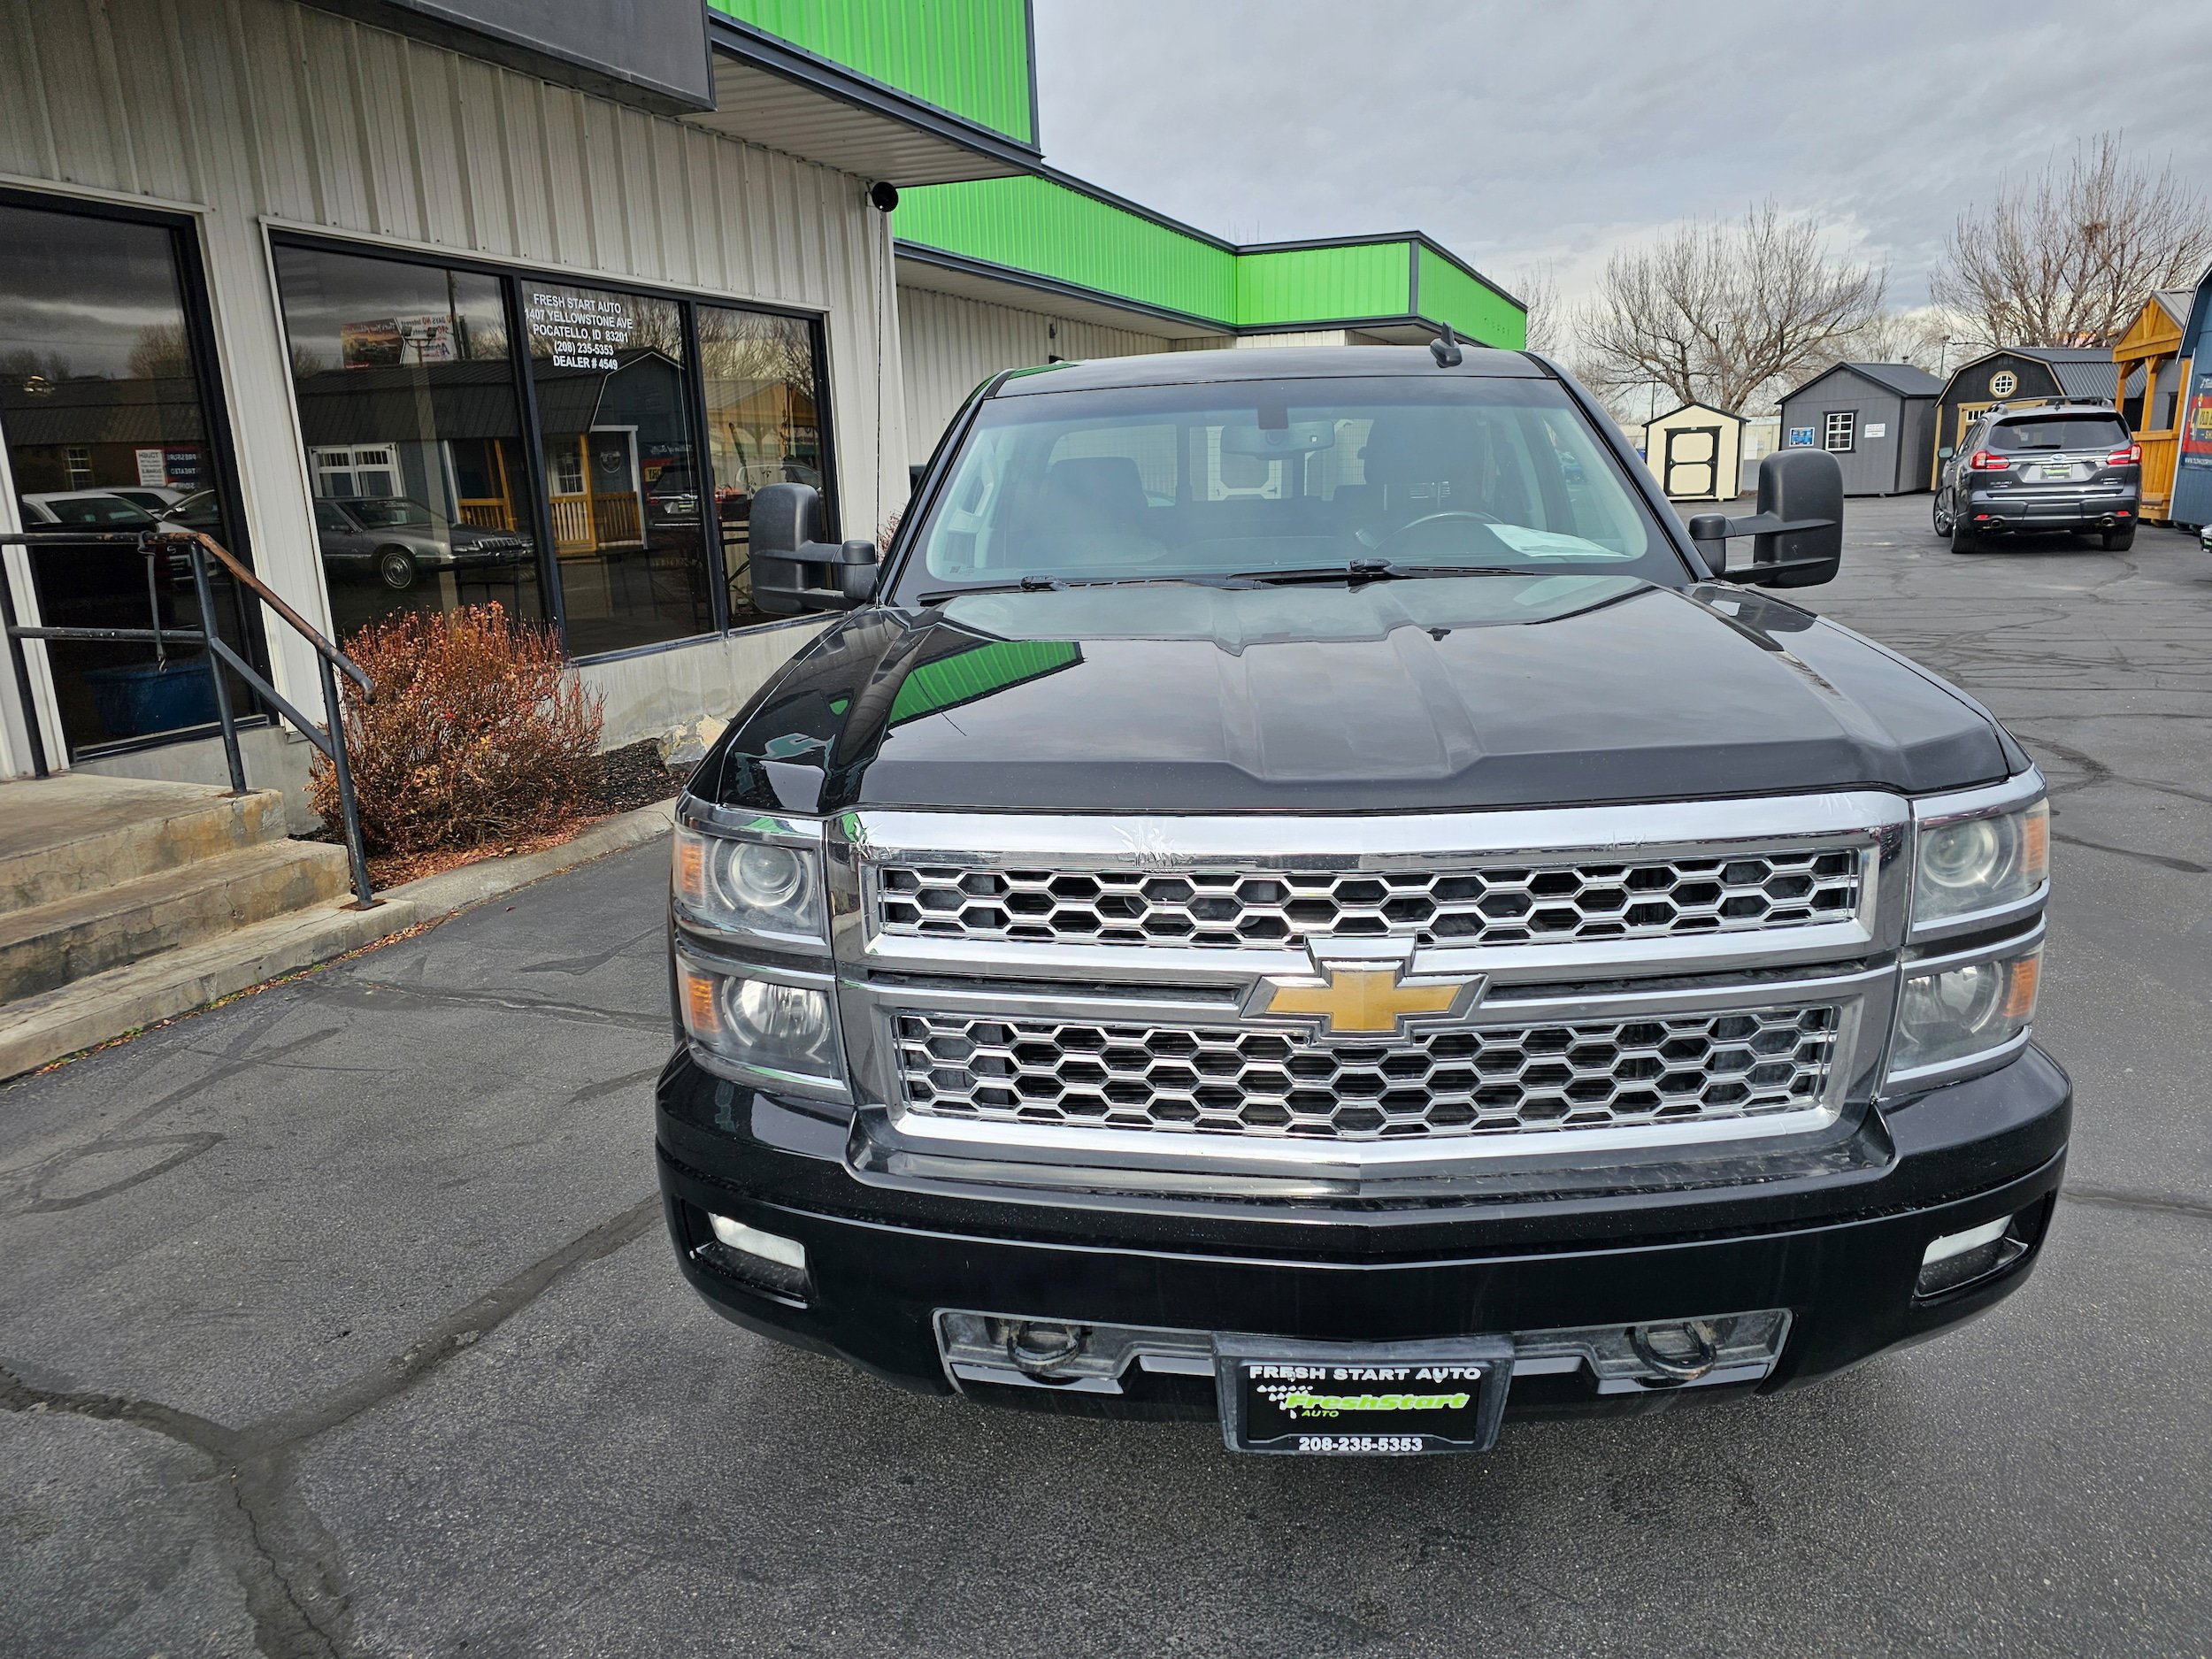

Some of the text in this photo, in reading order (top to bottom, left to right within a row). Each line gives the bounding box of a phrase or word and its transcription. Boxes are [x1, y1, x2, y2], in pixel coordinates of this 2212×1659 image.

[534, 293, 621, 314] FRESH START AUTO
[524, 308, 634, 329] 1407 YELLOWSTONE AVE
[533, 323, 629, 342] POCATELLO, ID 83201
[554, 340, 614, 356] (208) 235-5353
[552, 355, 618, 370] DEALER # 4549
[1249, 1366, 1481, 1381] FRESH START AUTO
[1298, 1437, 1424, 1452] 208-235-5353
